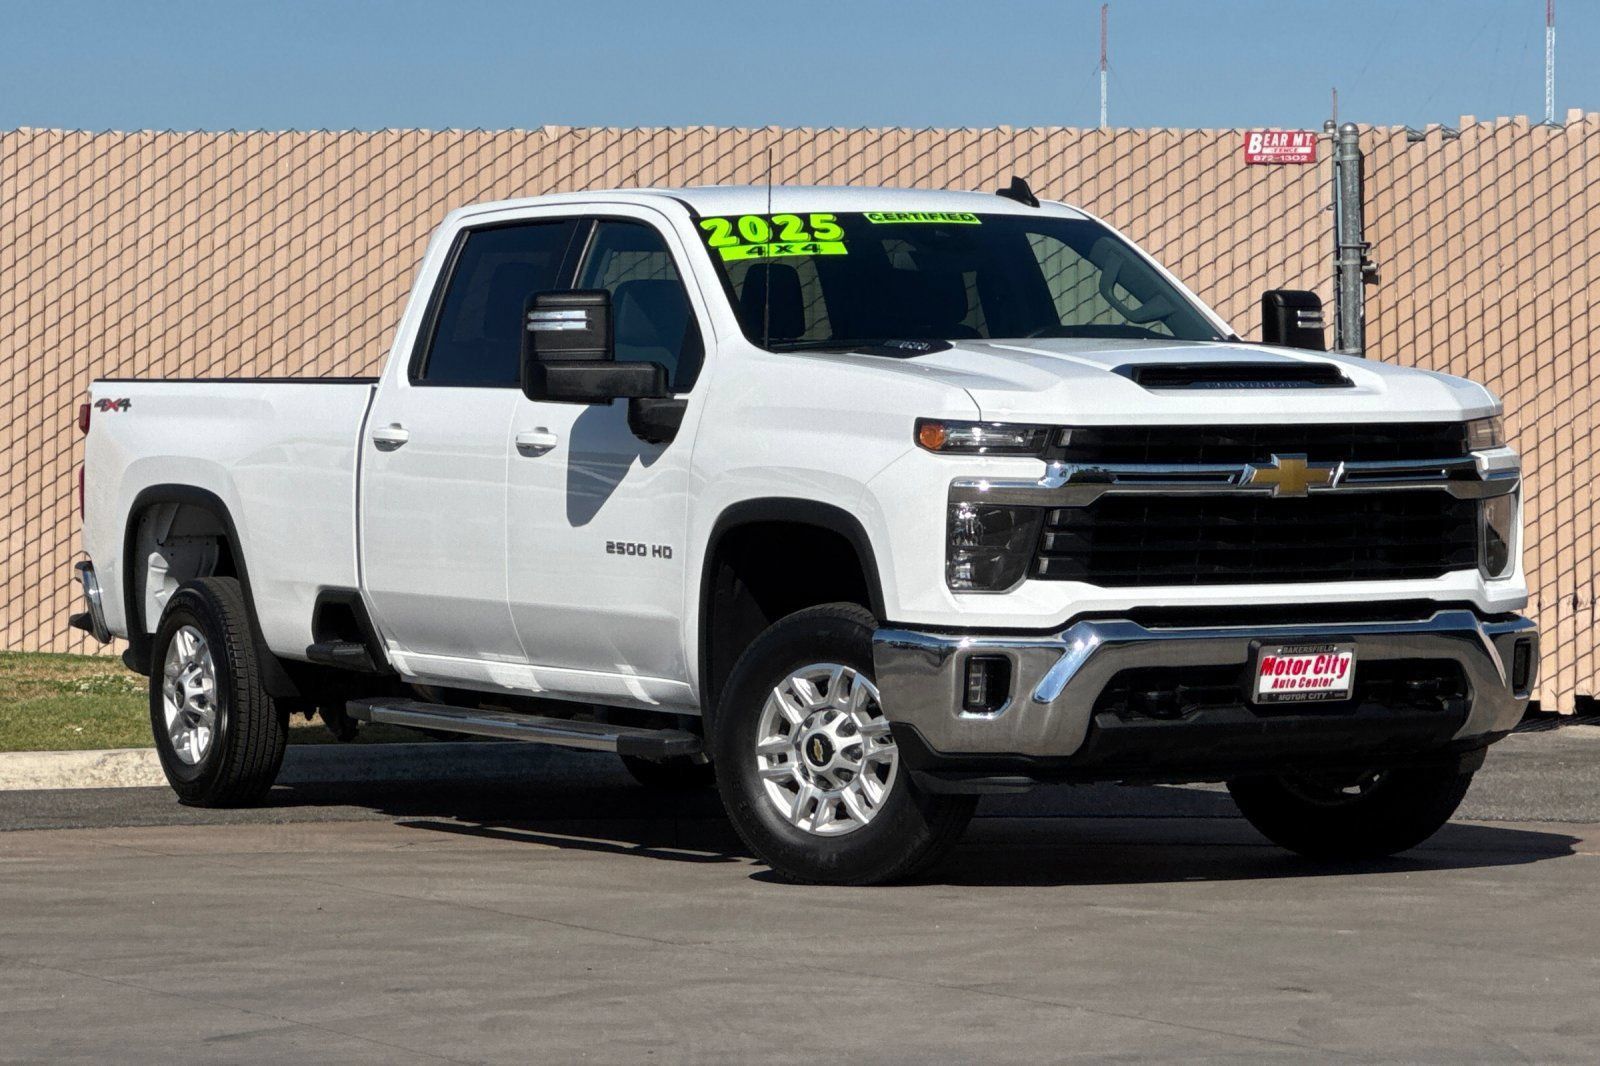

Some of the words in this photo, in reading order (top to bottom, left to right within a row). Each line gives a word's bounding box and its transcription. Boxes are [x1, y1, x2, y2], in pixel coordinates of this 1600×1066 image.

[1248, 133, 1289, 154] BEAR
[867, 212, 975, 221] CERTIFIED
[700, 214, 845, 247] 2025
[606, 541, 647, 556] 2500
[652, 545, 672, 559] HD
[1283, 645, 1334, 654] BAKERSFIELD
[1260, 656, 1312, 676] Motor
[1313, 655, 1350, 679] City
[1272, 678, 1297, 688] Auto
[1298, 677, 1334, 688] Center
[1278, 693, 1307, 701] MOTOR
[1308, 692, 1328, 700] CITY
